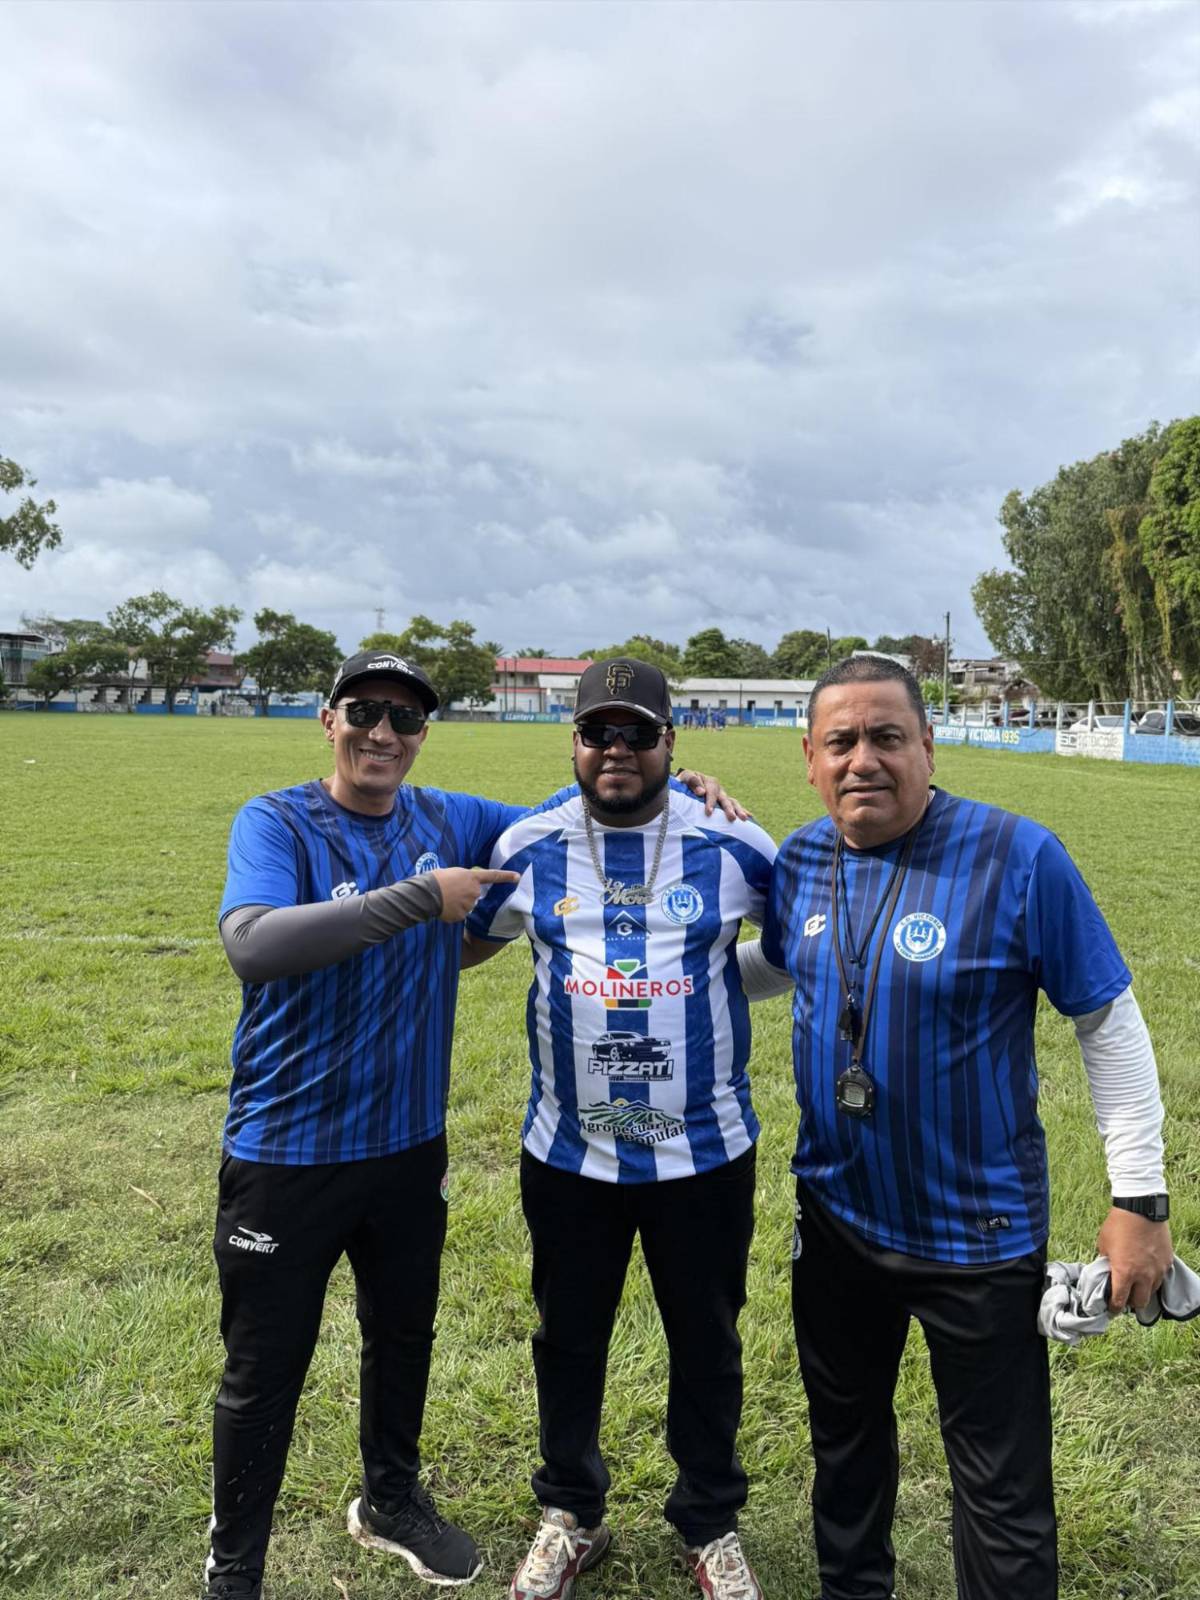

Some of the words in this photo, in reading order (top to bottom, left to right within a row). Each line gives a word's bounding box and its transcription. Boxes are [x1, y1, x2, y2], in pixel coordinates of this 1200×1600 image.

[968, 727, 1001, 743] VICTORIA
[565, 978, 693, 998] MOLINEROS
[588, 1058, 674, 1076] PIZZATI
[580, 1118, 676, 1136] Agropecuaria
[228, 1235, 280, 1254] CONVERT
